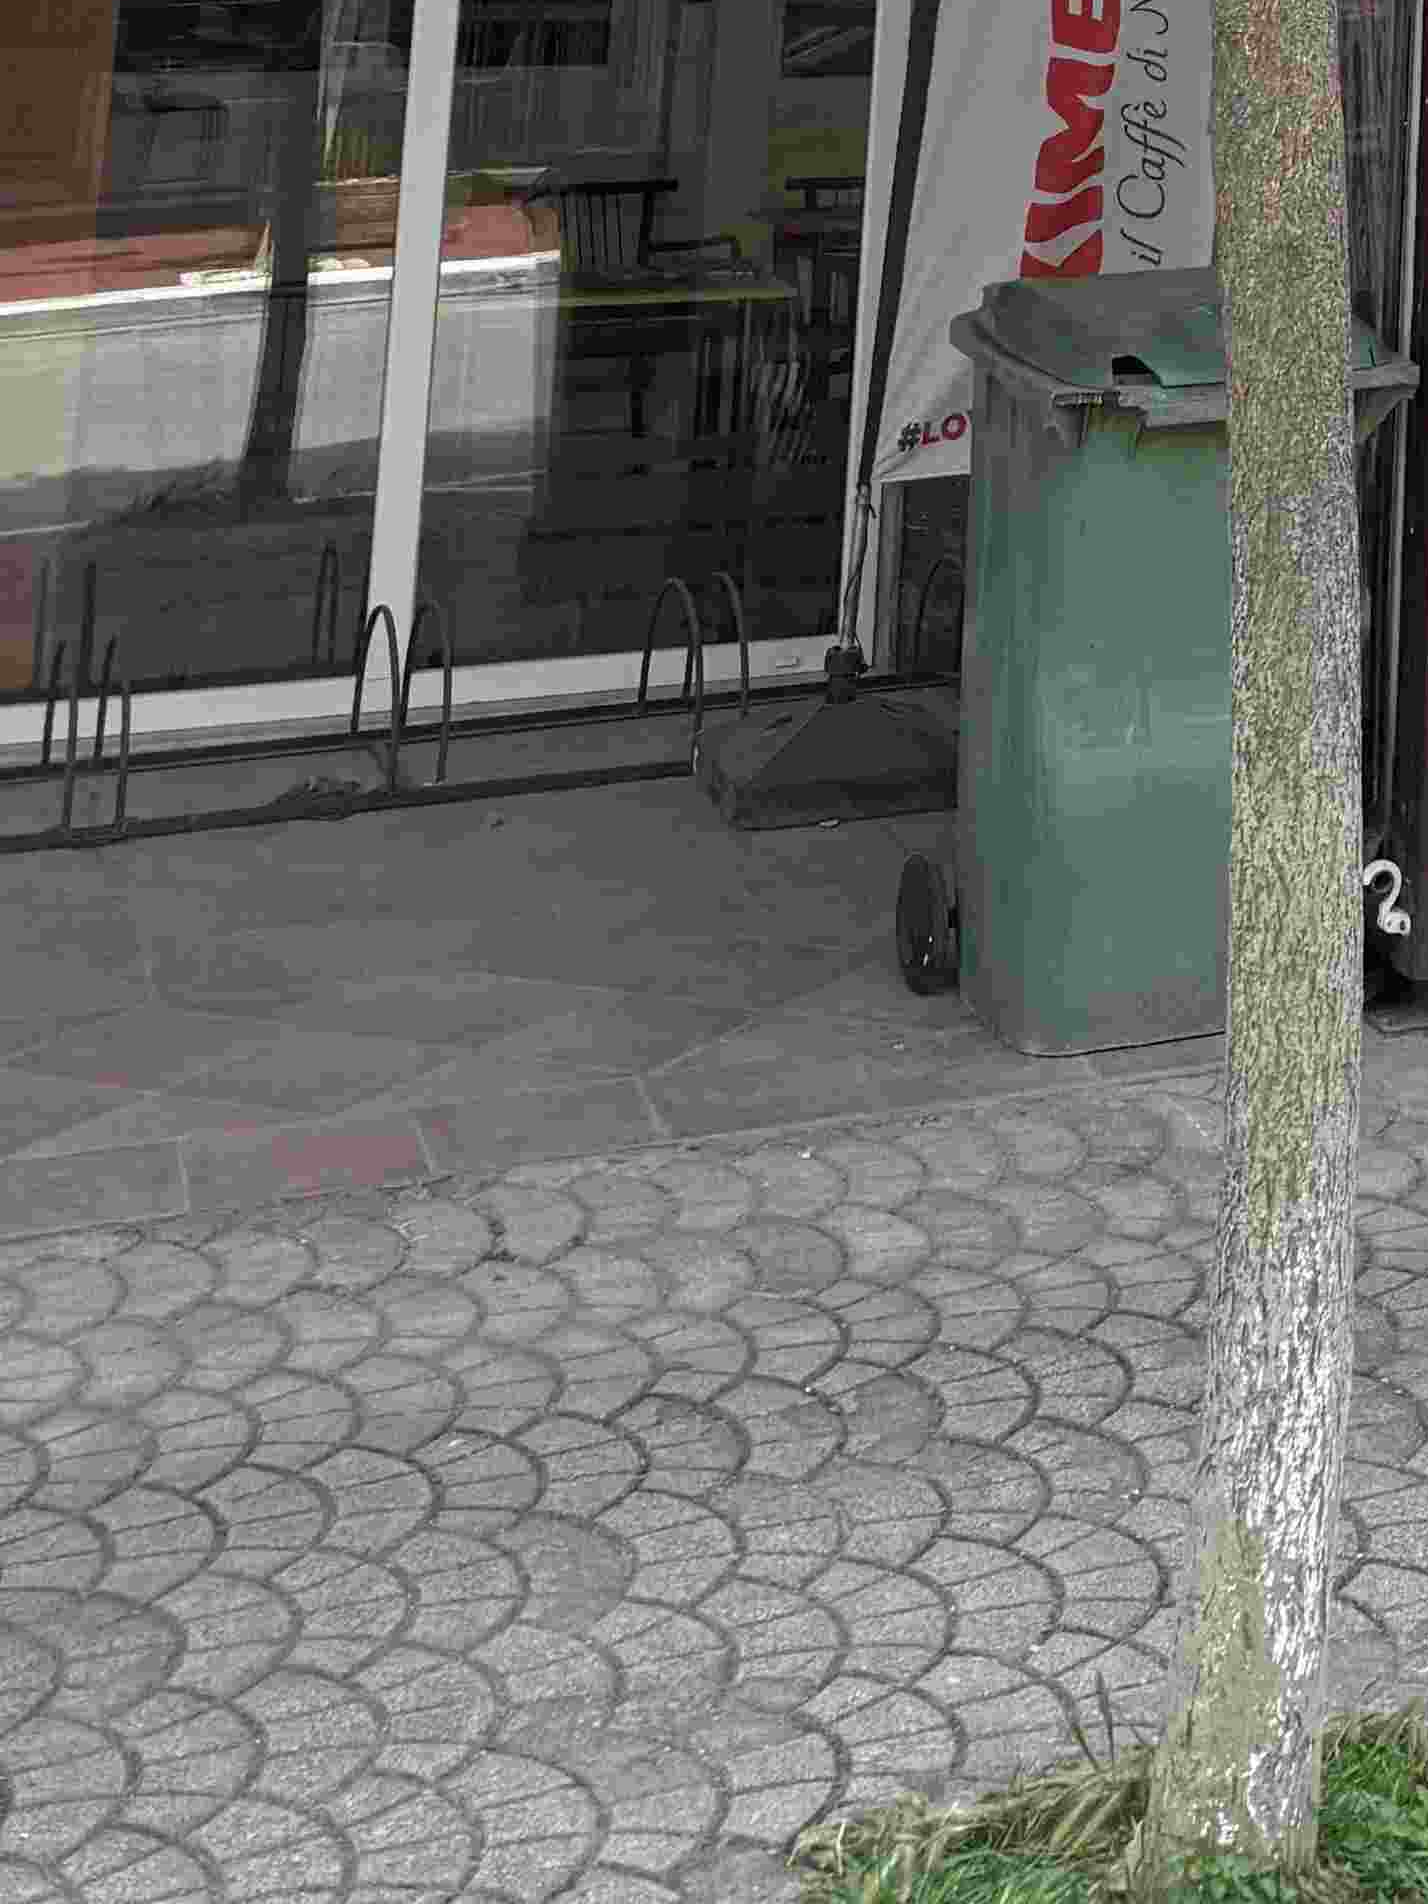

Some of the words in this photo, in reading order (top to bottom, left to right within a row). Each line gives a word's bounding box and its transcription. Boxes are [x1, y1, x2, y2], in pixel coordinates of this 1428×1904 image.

[1126, 47, 1169, 83] di
[1116, 98, 1188, 219] Caffè
[1119, 226, 1164, 266] il
